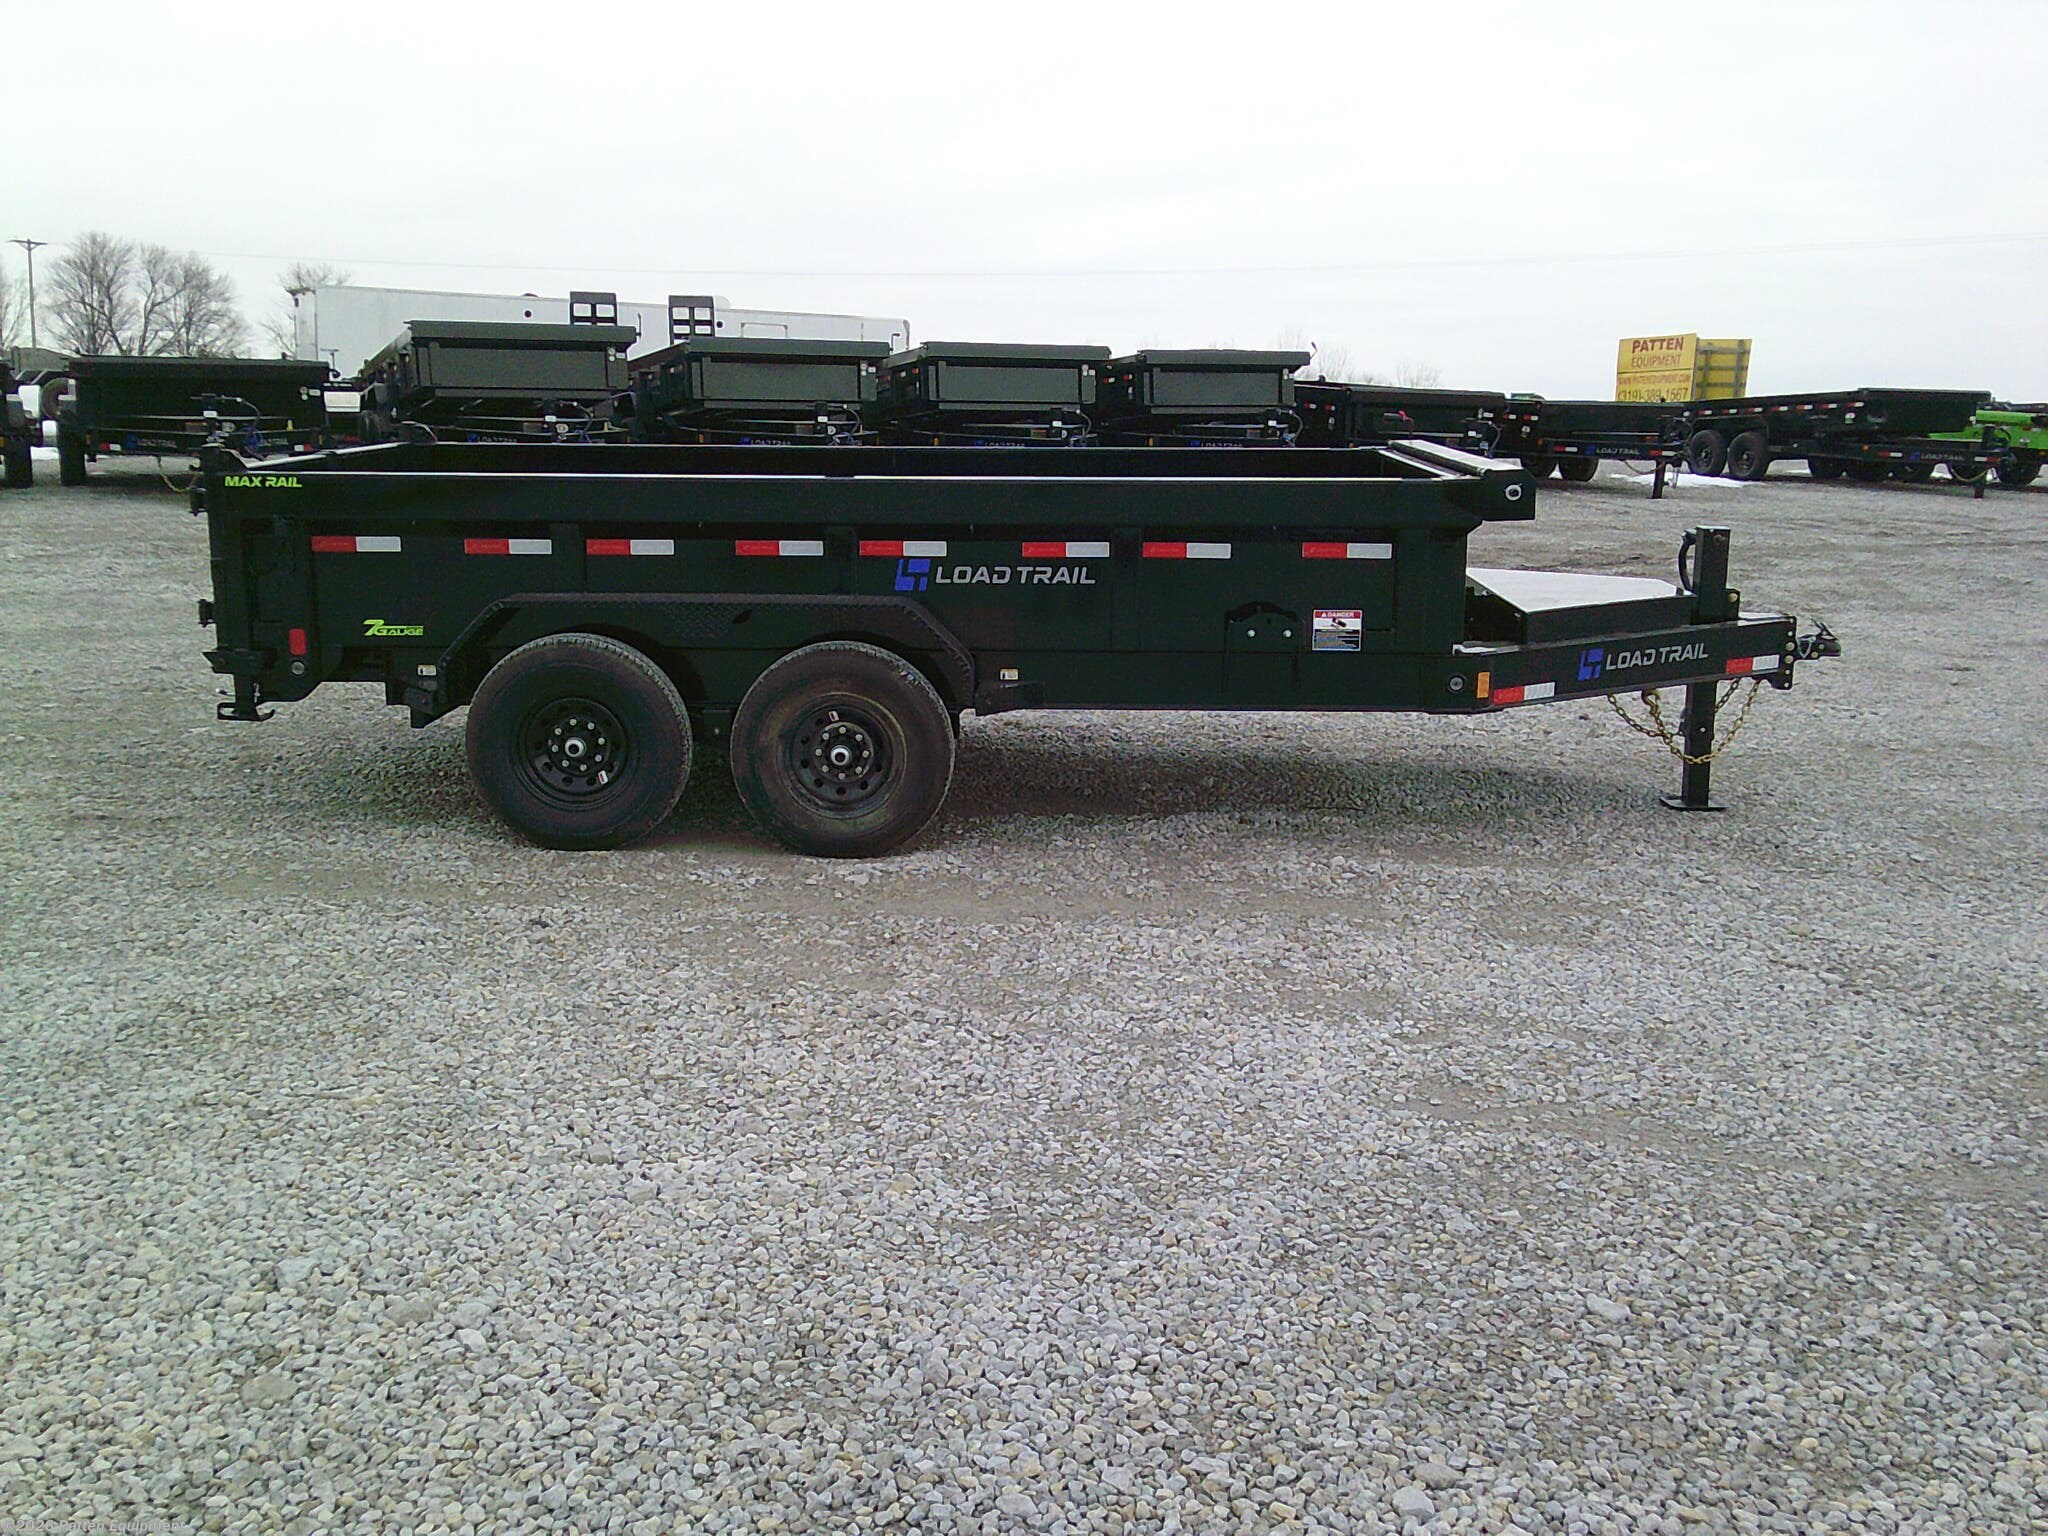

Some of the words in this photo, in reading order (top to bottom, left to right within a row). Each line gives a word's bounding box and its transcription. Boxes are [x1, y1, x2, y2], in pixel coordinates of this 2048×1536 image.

[1631, 337, 1684, 353] PATTEN
[1631, 354, 1681, 368] EQUIPMENT
[225, 476, 262, 487] MAX
[265, 477, 303, 488] RAIL
[935, 566, 1011, 584] LOAD
[1016, 566, 1096, 584] TRAIL
[374, 626, 424, 636] GAUGE
[1605, 648, 1656, 671] LOAD
[1659, 642, 1709, 664] TRAIL
